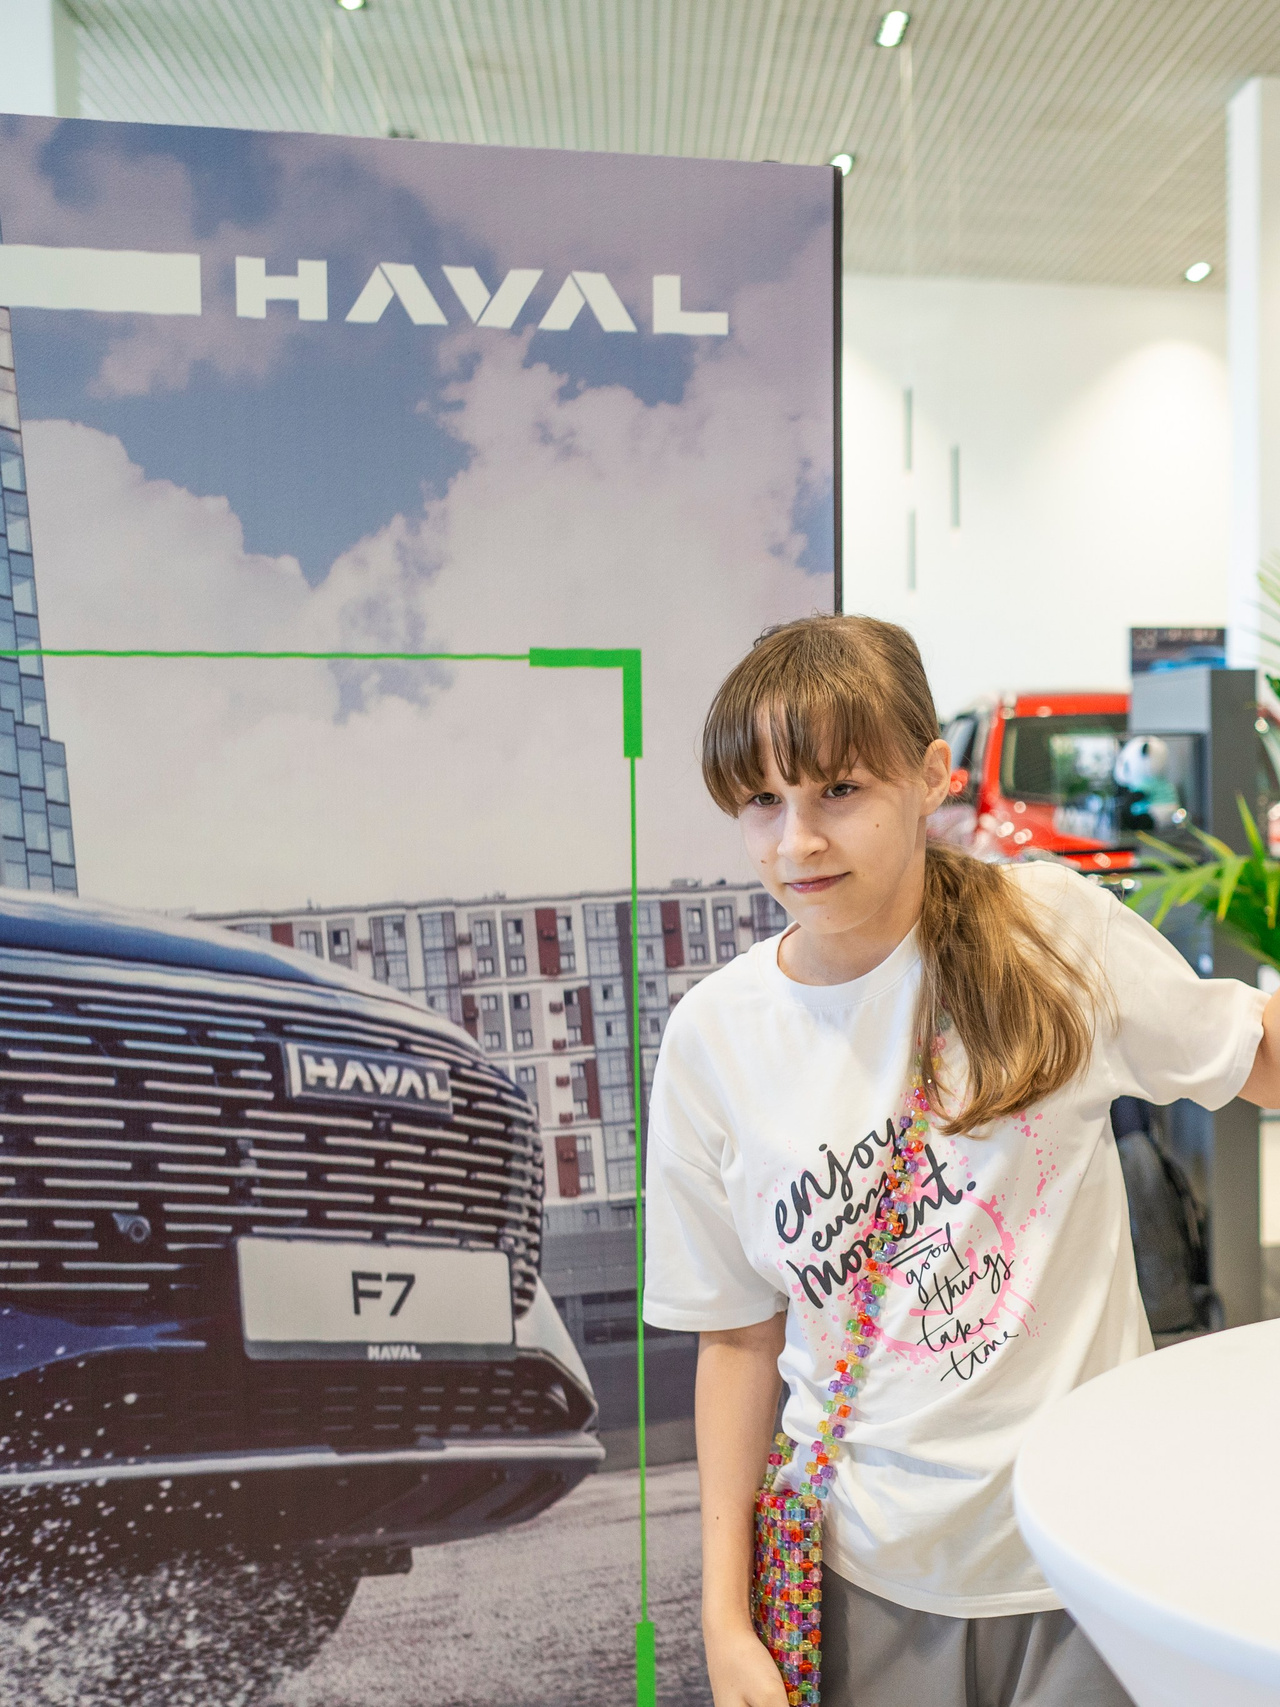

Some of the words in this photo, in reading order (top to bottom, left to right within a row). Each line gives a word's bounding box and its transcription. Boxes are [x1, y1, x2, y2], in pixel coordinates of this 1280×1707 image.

[236, 256, 729, 336] HAVAL
[302, 1054, 451, 1101] HAVAL
[775, 1118, 908, 1244] enjoy
[906, 1222, 964, 1304] good
[924, 1253, 1014, 1315] things
[351, 1270, 416, 1317] F7
[367, 1345, 421, 1361] HAVAL
[917, 1316, 996, 1352] take
[941, 1331, 1019, 1380] time
